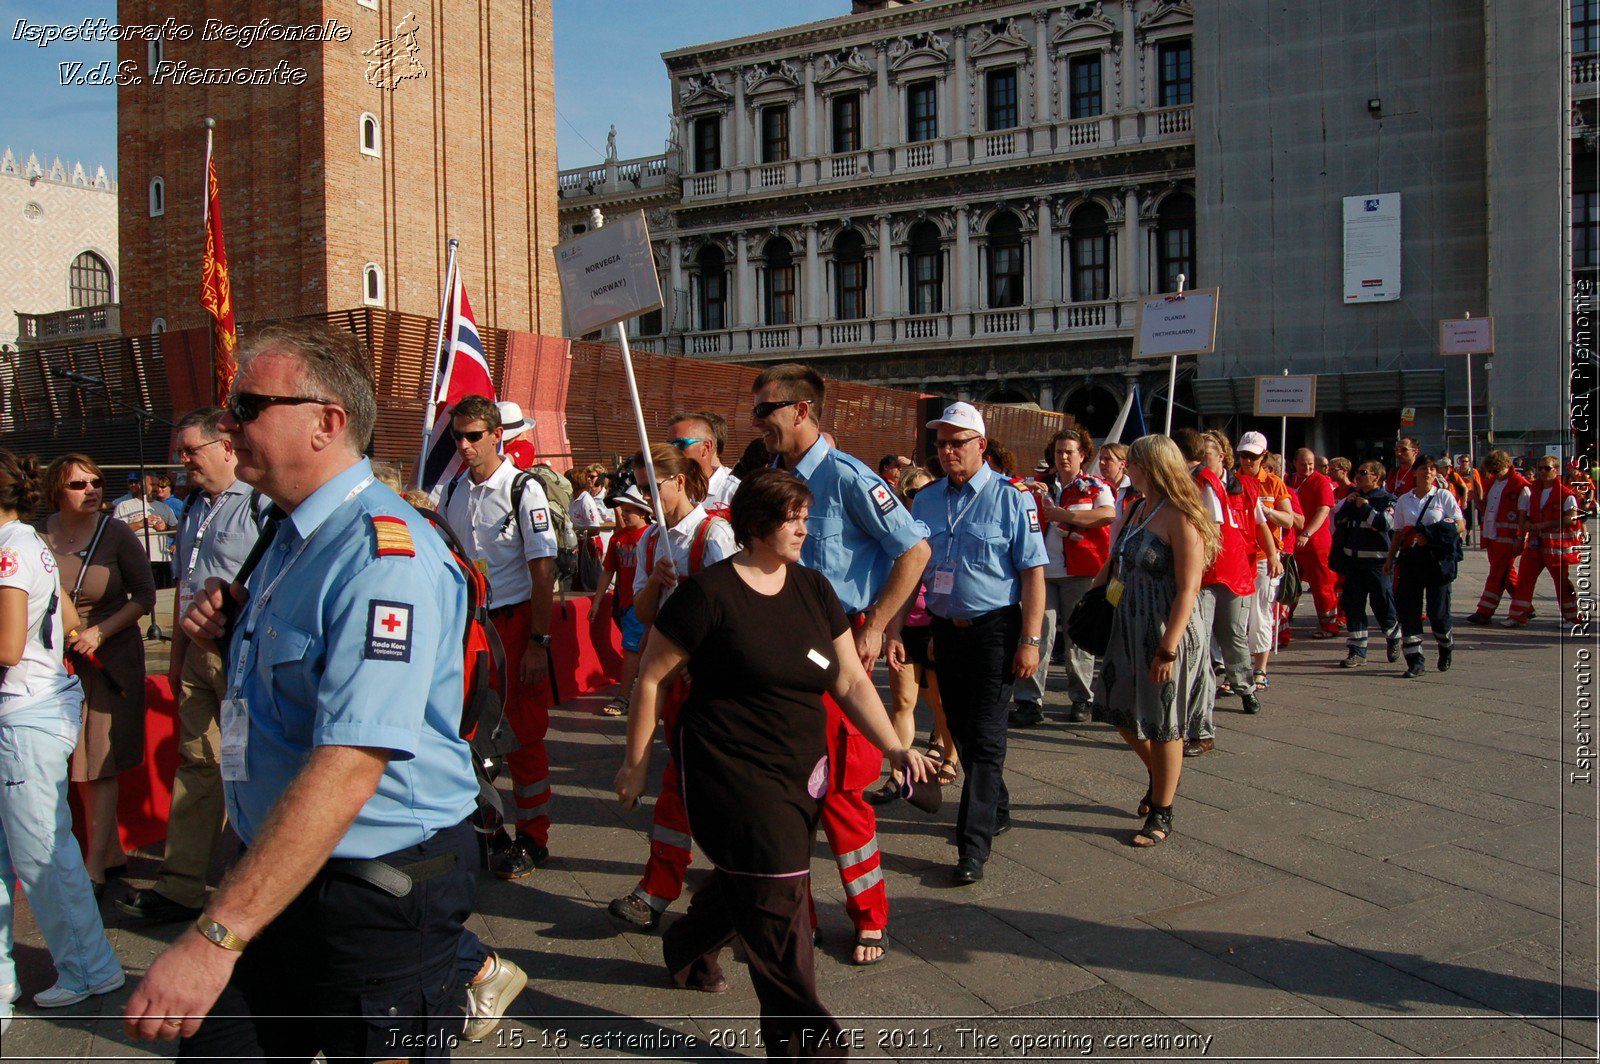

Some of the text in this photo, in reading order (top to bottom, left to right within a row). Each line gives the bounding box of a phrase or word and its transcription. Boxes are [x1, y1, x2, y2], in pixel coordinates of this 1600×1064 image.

[585, 254, 621, 274] NORVEGIA
[590, 278, 627, 299] (NORWAY)
[1164, 314, 1186, 322] OLANDA
